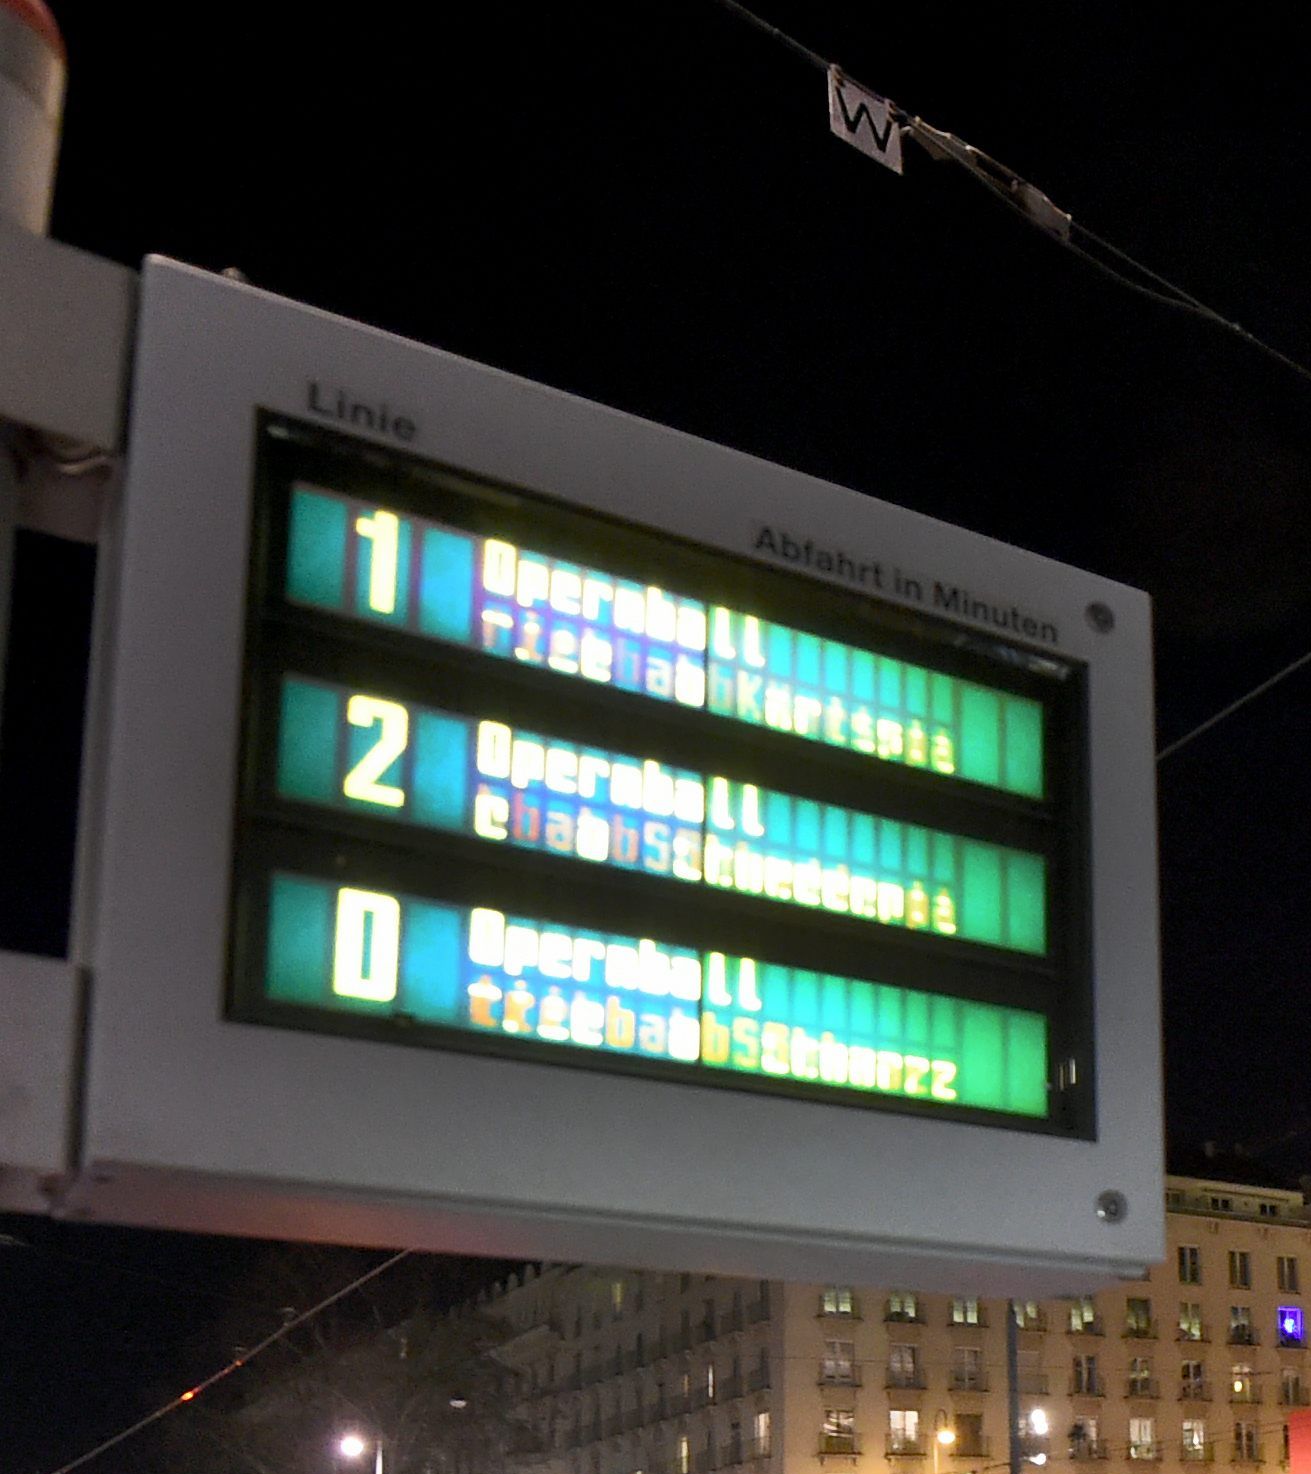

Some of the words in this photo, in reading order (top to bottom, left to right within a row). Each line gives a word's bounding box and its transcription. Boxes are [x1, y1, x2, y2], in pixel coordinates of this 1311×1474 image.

[307, 382, 416, 442] Linie
[355, 510, 399, 614] 1
[482, 538, 766, 667] Opernball
[754, 526, 883, 589] Abfahrt
[894, 574, 922, 601] in
[933, 580, 1058, 643] Minuten
[343, 694, 409, 807] 2
[475, 720, 765, 837] Opernball
[468, 907, 763, 1012] Opernball
